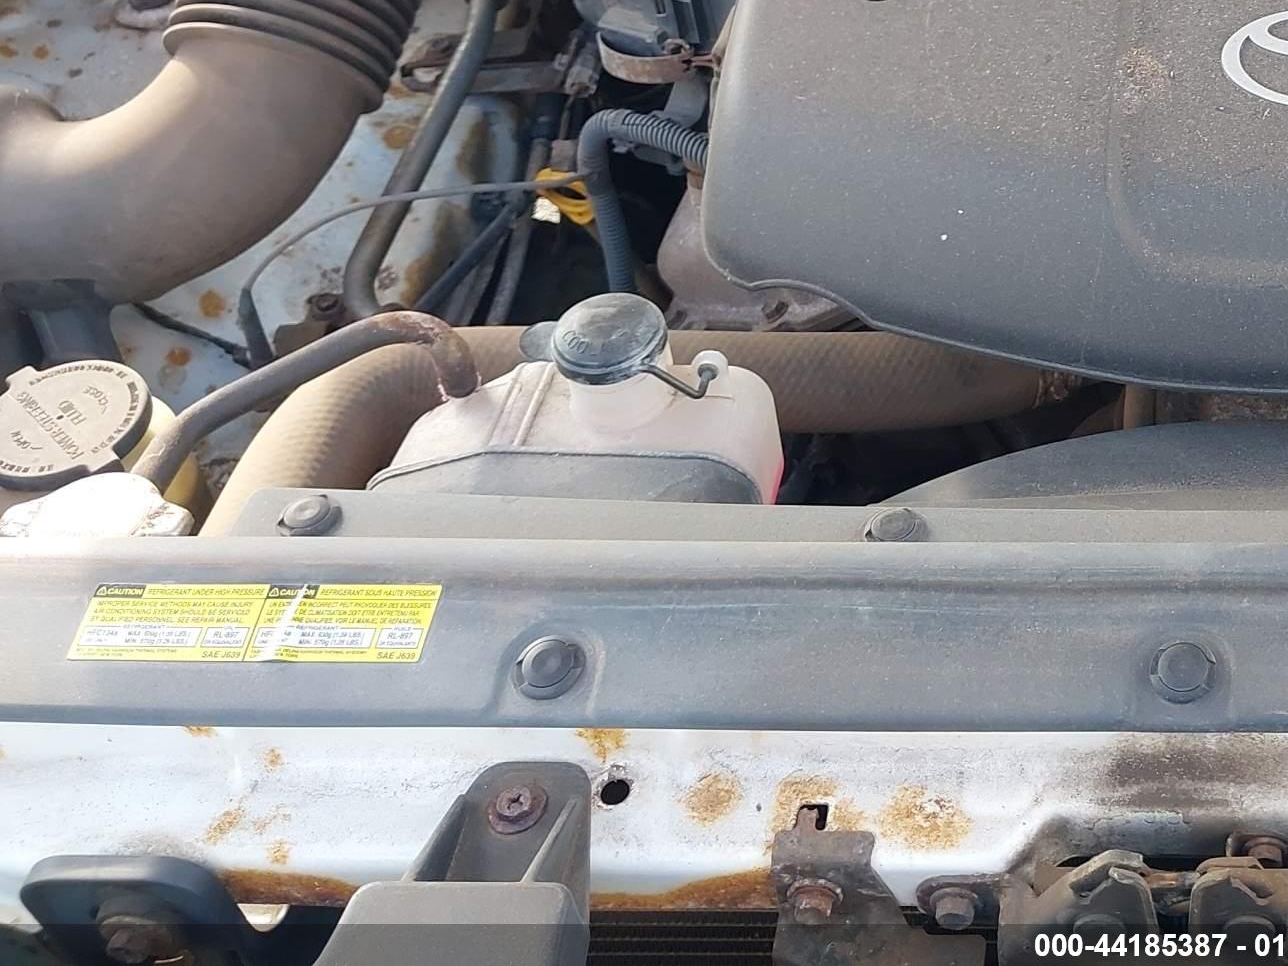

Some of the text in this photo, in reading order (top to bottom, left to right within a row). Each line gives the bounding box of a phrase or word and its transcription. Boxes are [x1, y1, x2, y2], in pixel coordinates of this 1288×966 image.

[107, 586, 144, 595] CAUTION
[147, 588, 265, 596] REFRIGERANT UNDER HIGH PRESSURE
[387, 632, 413, 640] RL-897
[201, 651, 221, 659] SAE
[221, 651, 241, 659] J639
[376, 651, 395, 659] SAE
[395, 652, 416, 660] J639
